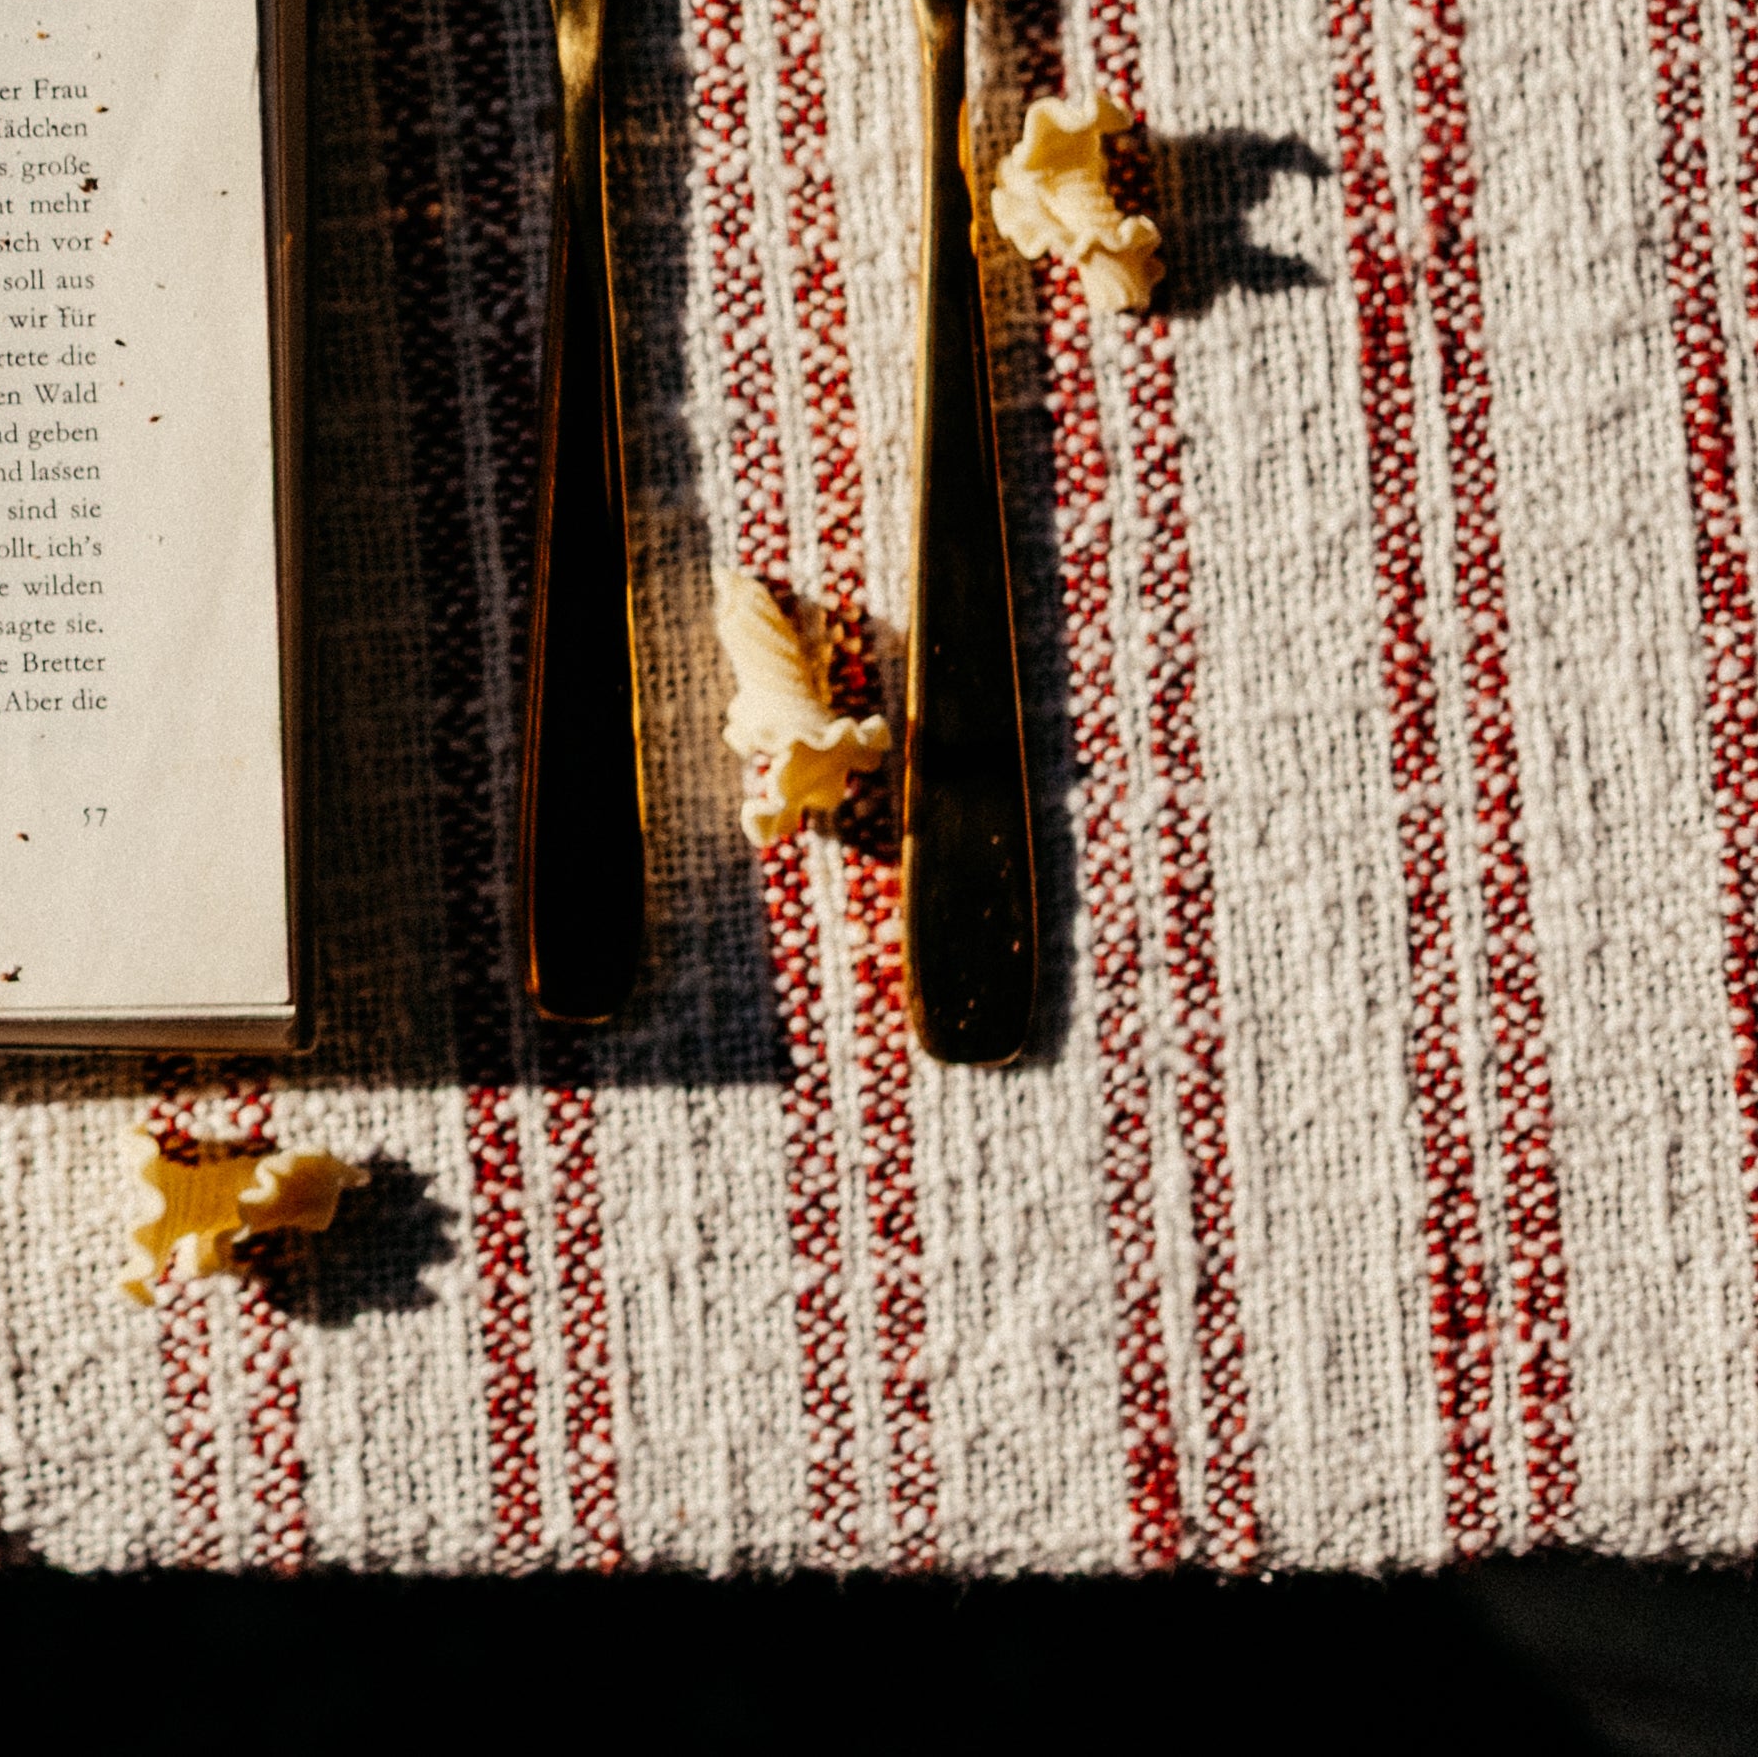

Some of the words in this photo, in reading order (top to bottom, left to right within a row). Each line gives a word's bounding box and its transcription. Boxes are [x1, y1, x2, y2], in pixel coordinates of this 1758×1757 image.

[35, 78, 87, 100] Frau
[22, 155, 91, 184] große
[30, 193, 91, 215] mehr
[4, 270, 44, 292] soll
[58, 307, 95, 329] für
[35, 382, 97, 404] Wald
[28, 422, 98, 452] geben
[31, 458, 100, 480] lassen
[8, 498, 57, 520] sind
[49, 535, 102, 557] ich’s
[23, 574, 102, 596] wilden
[67, 612, 103, 633] sie.
[23, 649, 105, 671] Bretter
[82, 807, 108, 827] 57
